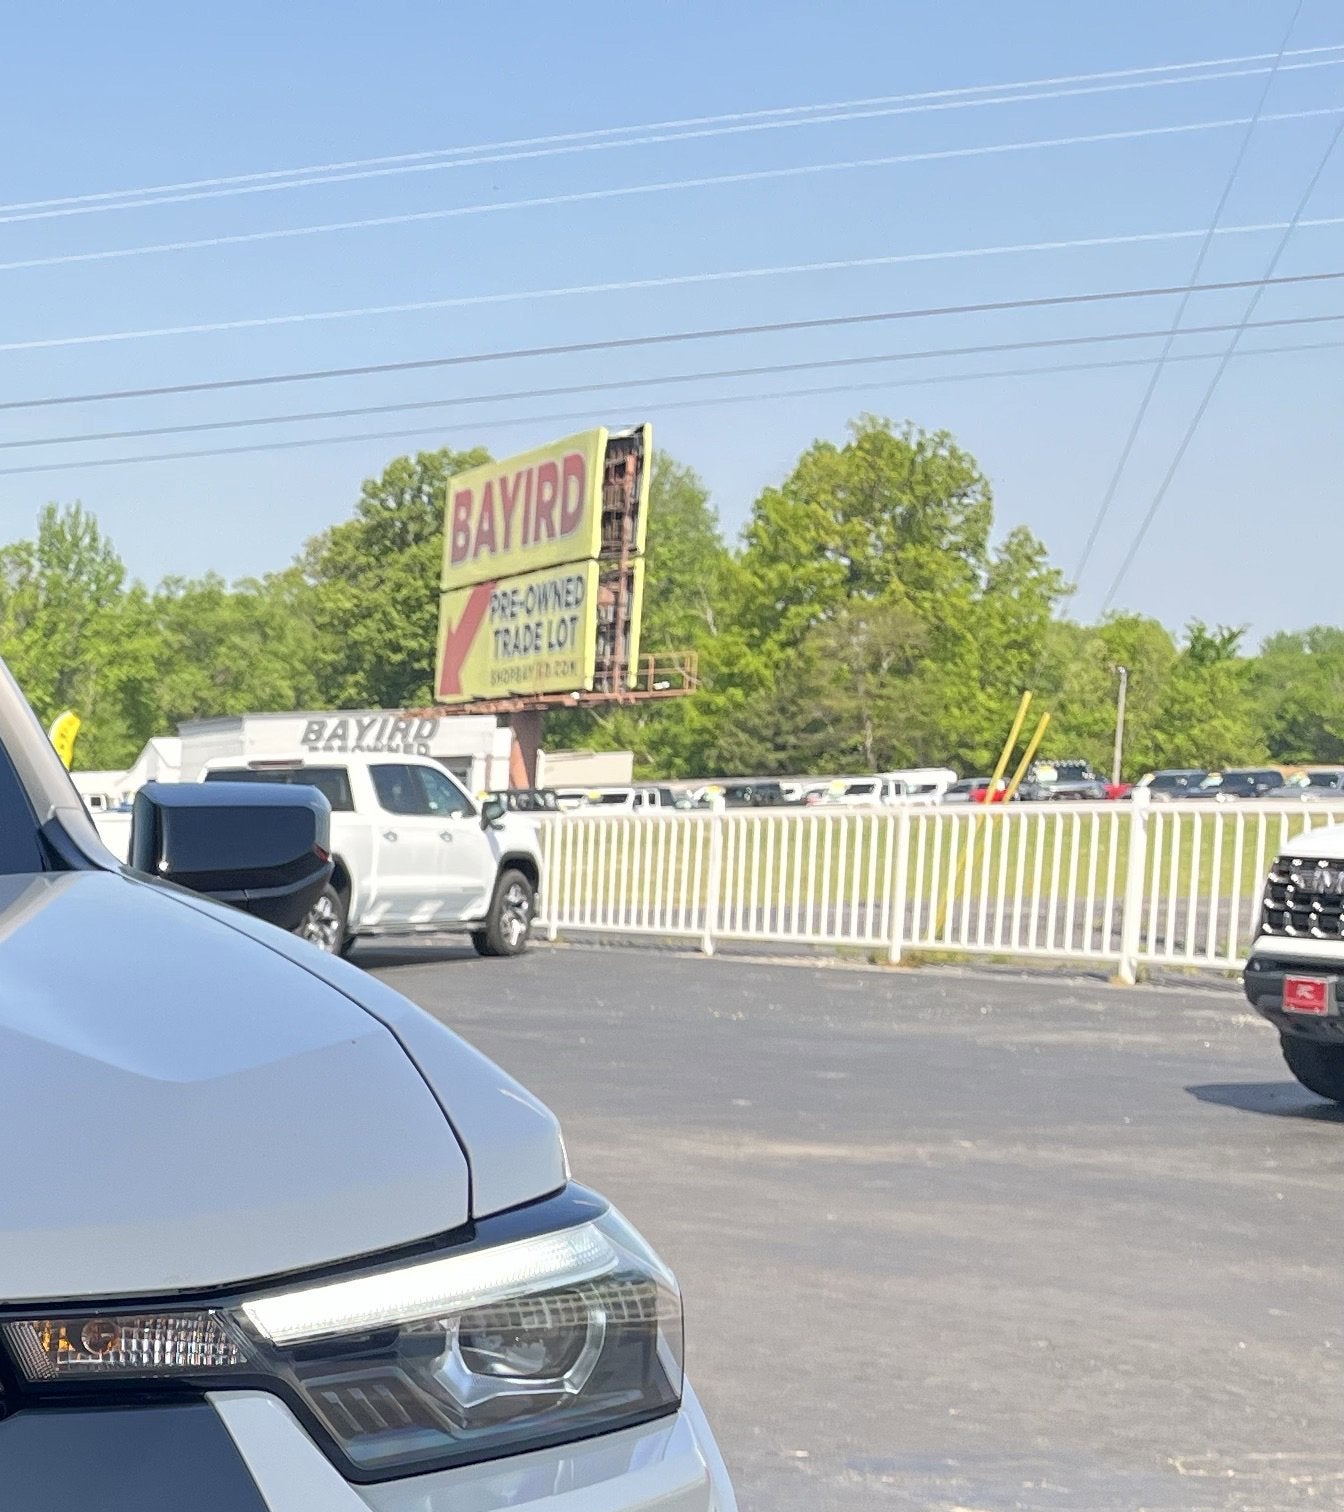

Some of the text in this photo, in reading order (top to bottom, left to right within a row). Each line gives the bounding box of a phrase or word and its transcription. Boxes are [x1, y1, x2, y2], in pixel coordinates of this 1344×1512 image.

[450, 452, 587, 567] BAYIRD
[489, 575, 585, 624] PRE-OWNED
[494, 615, 579, 661] TRADE LOT
[301, 717, 441, 745] BAYIRD
